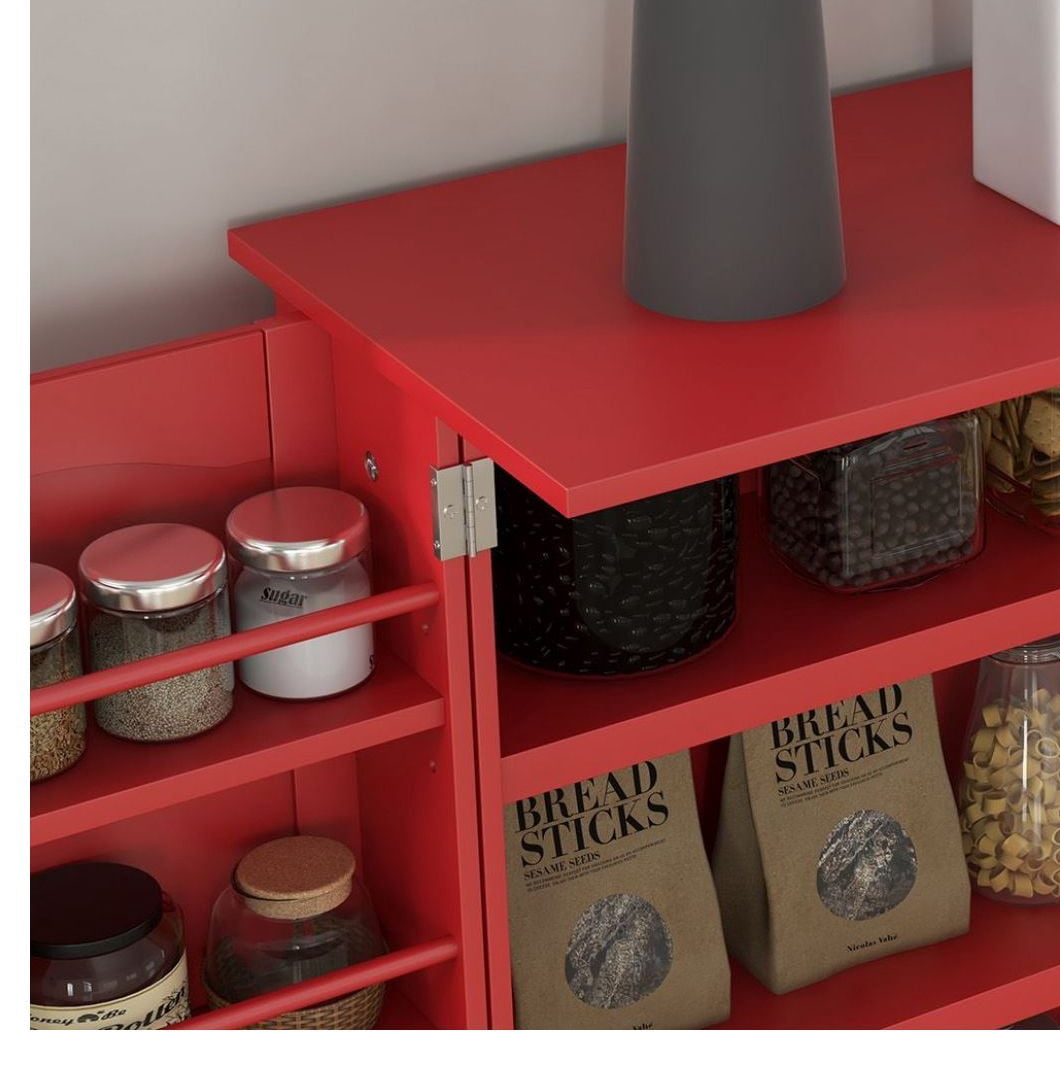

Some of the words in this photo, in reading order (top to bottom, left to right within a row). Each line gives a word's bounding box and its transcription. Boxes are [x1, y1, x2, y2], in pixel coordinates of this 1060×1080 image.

[771, 683, 903, 751] BREAD
[775, 710, 913, 784] STICKS
[515, 760, 658, 834] BREAD
[778, 776, 820, 797] SESAME
[820, 767, 850, 785] SEEDS
[520, 790, 670, 868] STICKS
[523, 861, 568, 882] SESAME
[568, 851, 601, 868] SEEDS
[30, 1015, 74, 1026] oney
